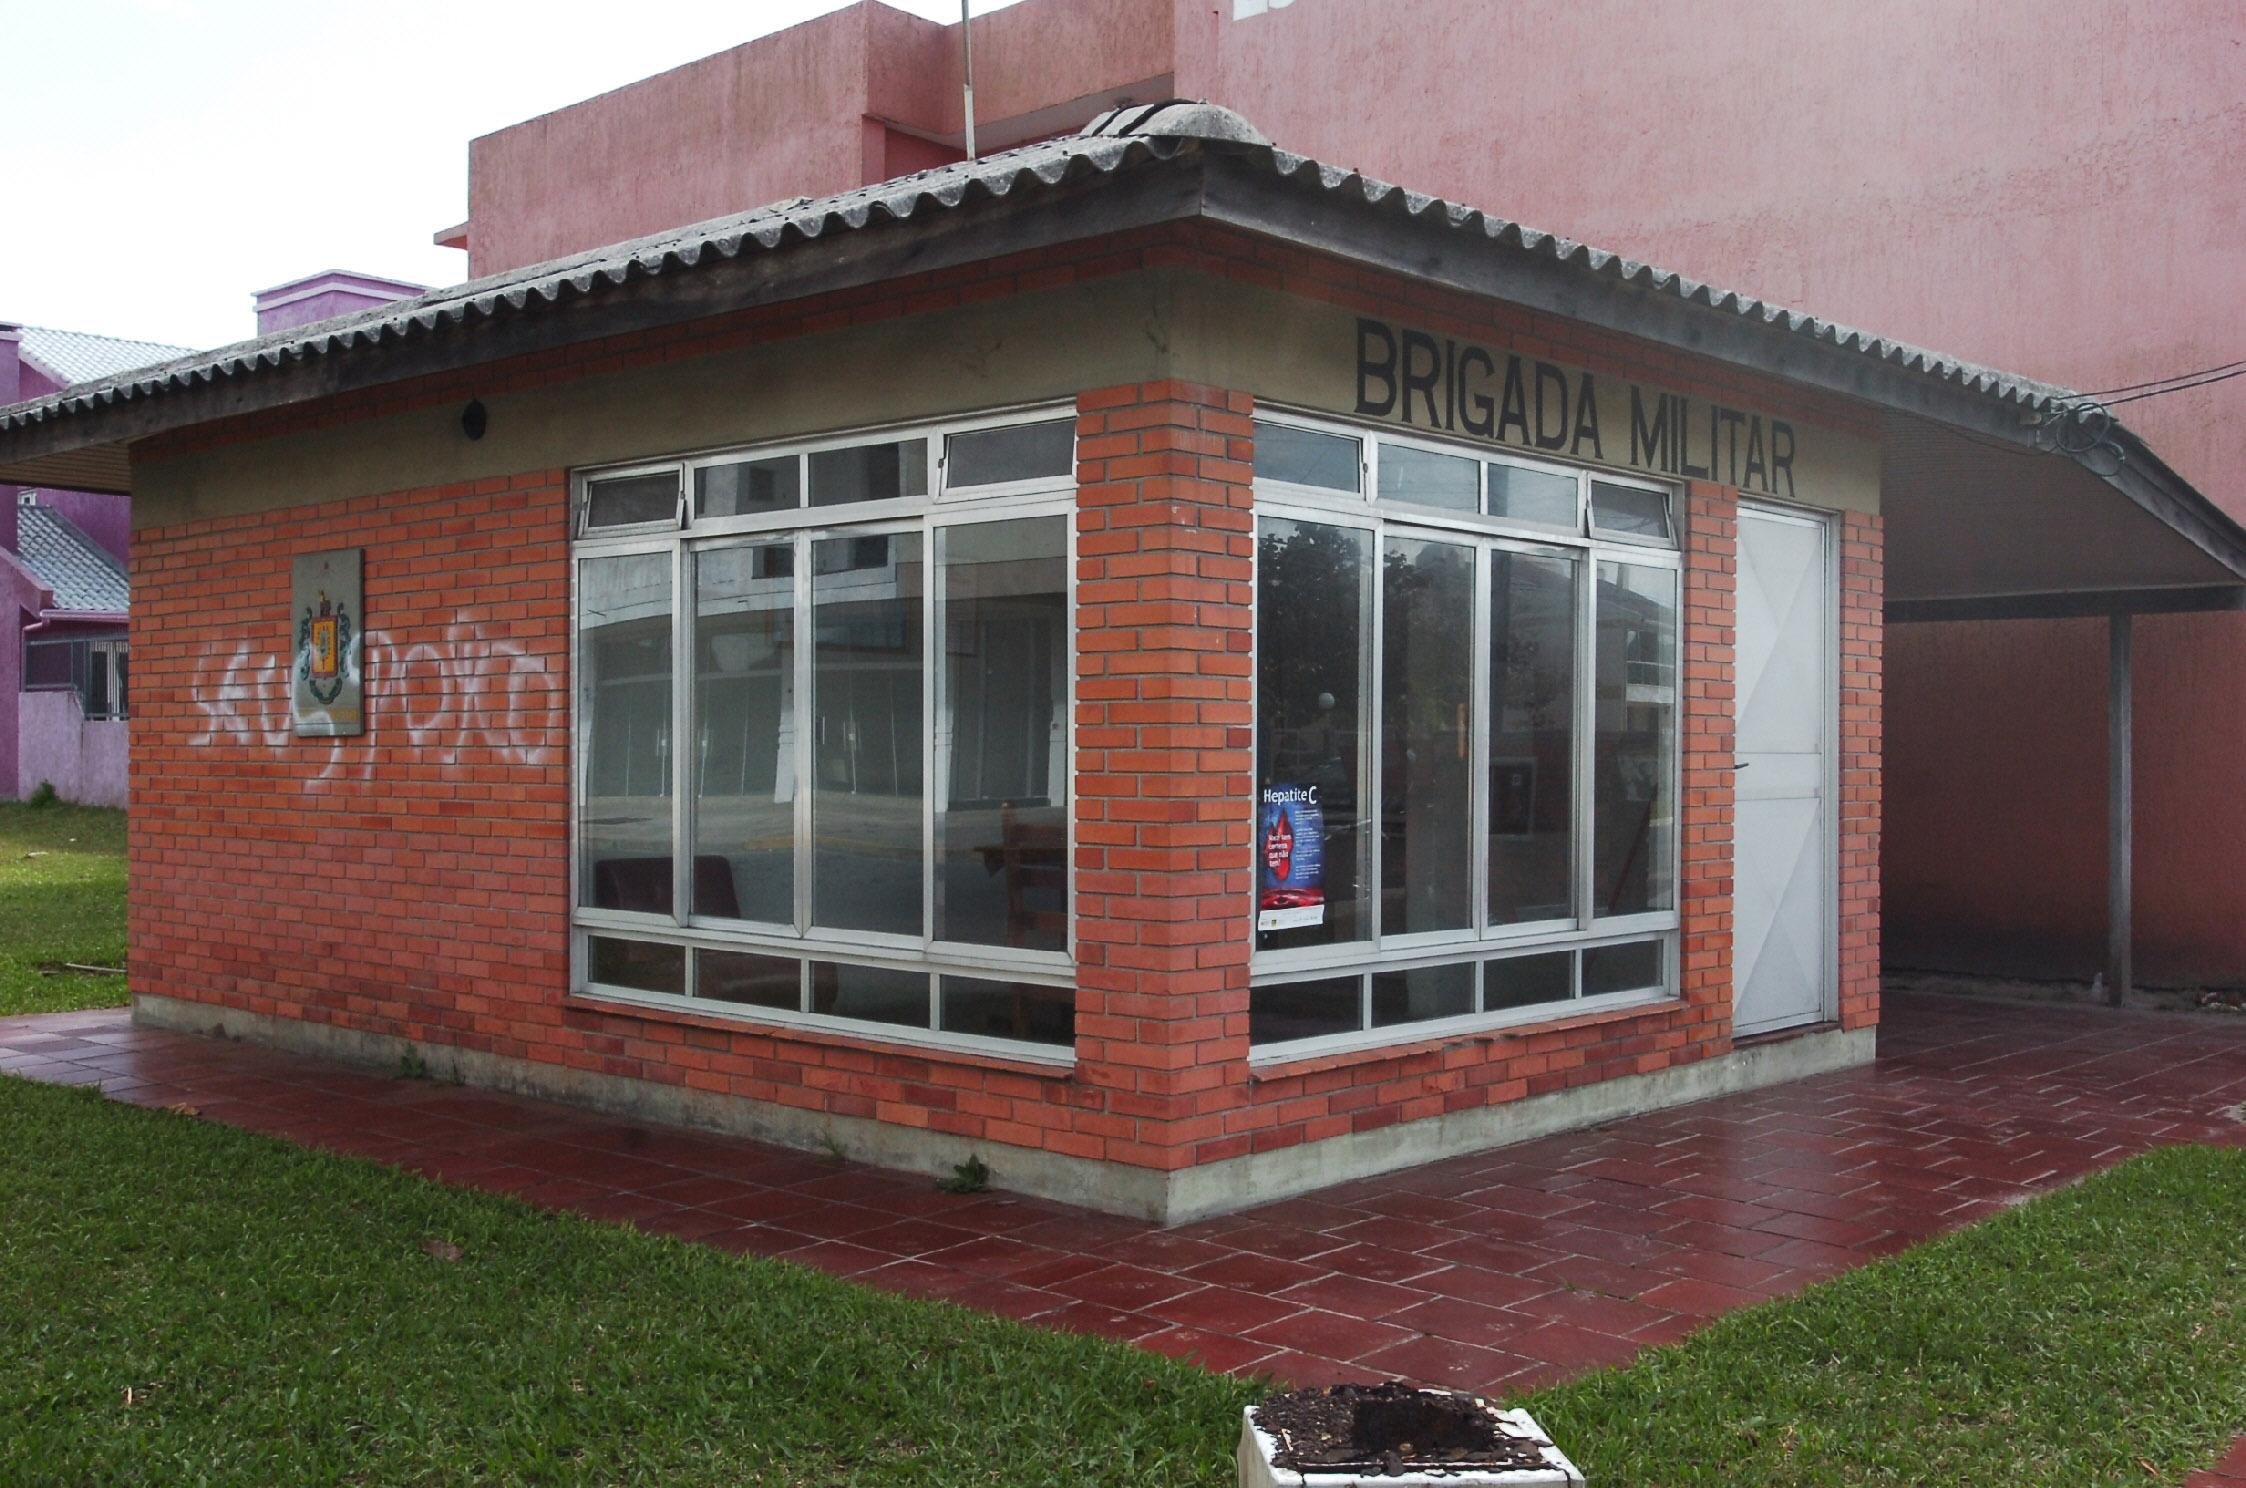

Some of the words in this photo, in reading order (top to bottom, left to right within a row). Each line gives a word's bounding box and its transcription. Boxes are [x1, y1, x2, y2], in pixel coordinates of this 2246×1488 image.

[1354, 317, 1603, 459] BRIGADA
[1630, 385, 1796, 498] MILITAR
[1263, 787, 1308, 806] Hepatite
[1308, 785, 1317, 805] C
